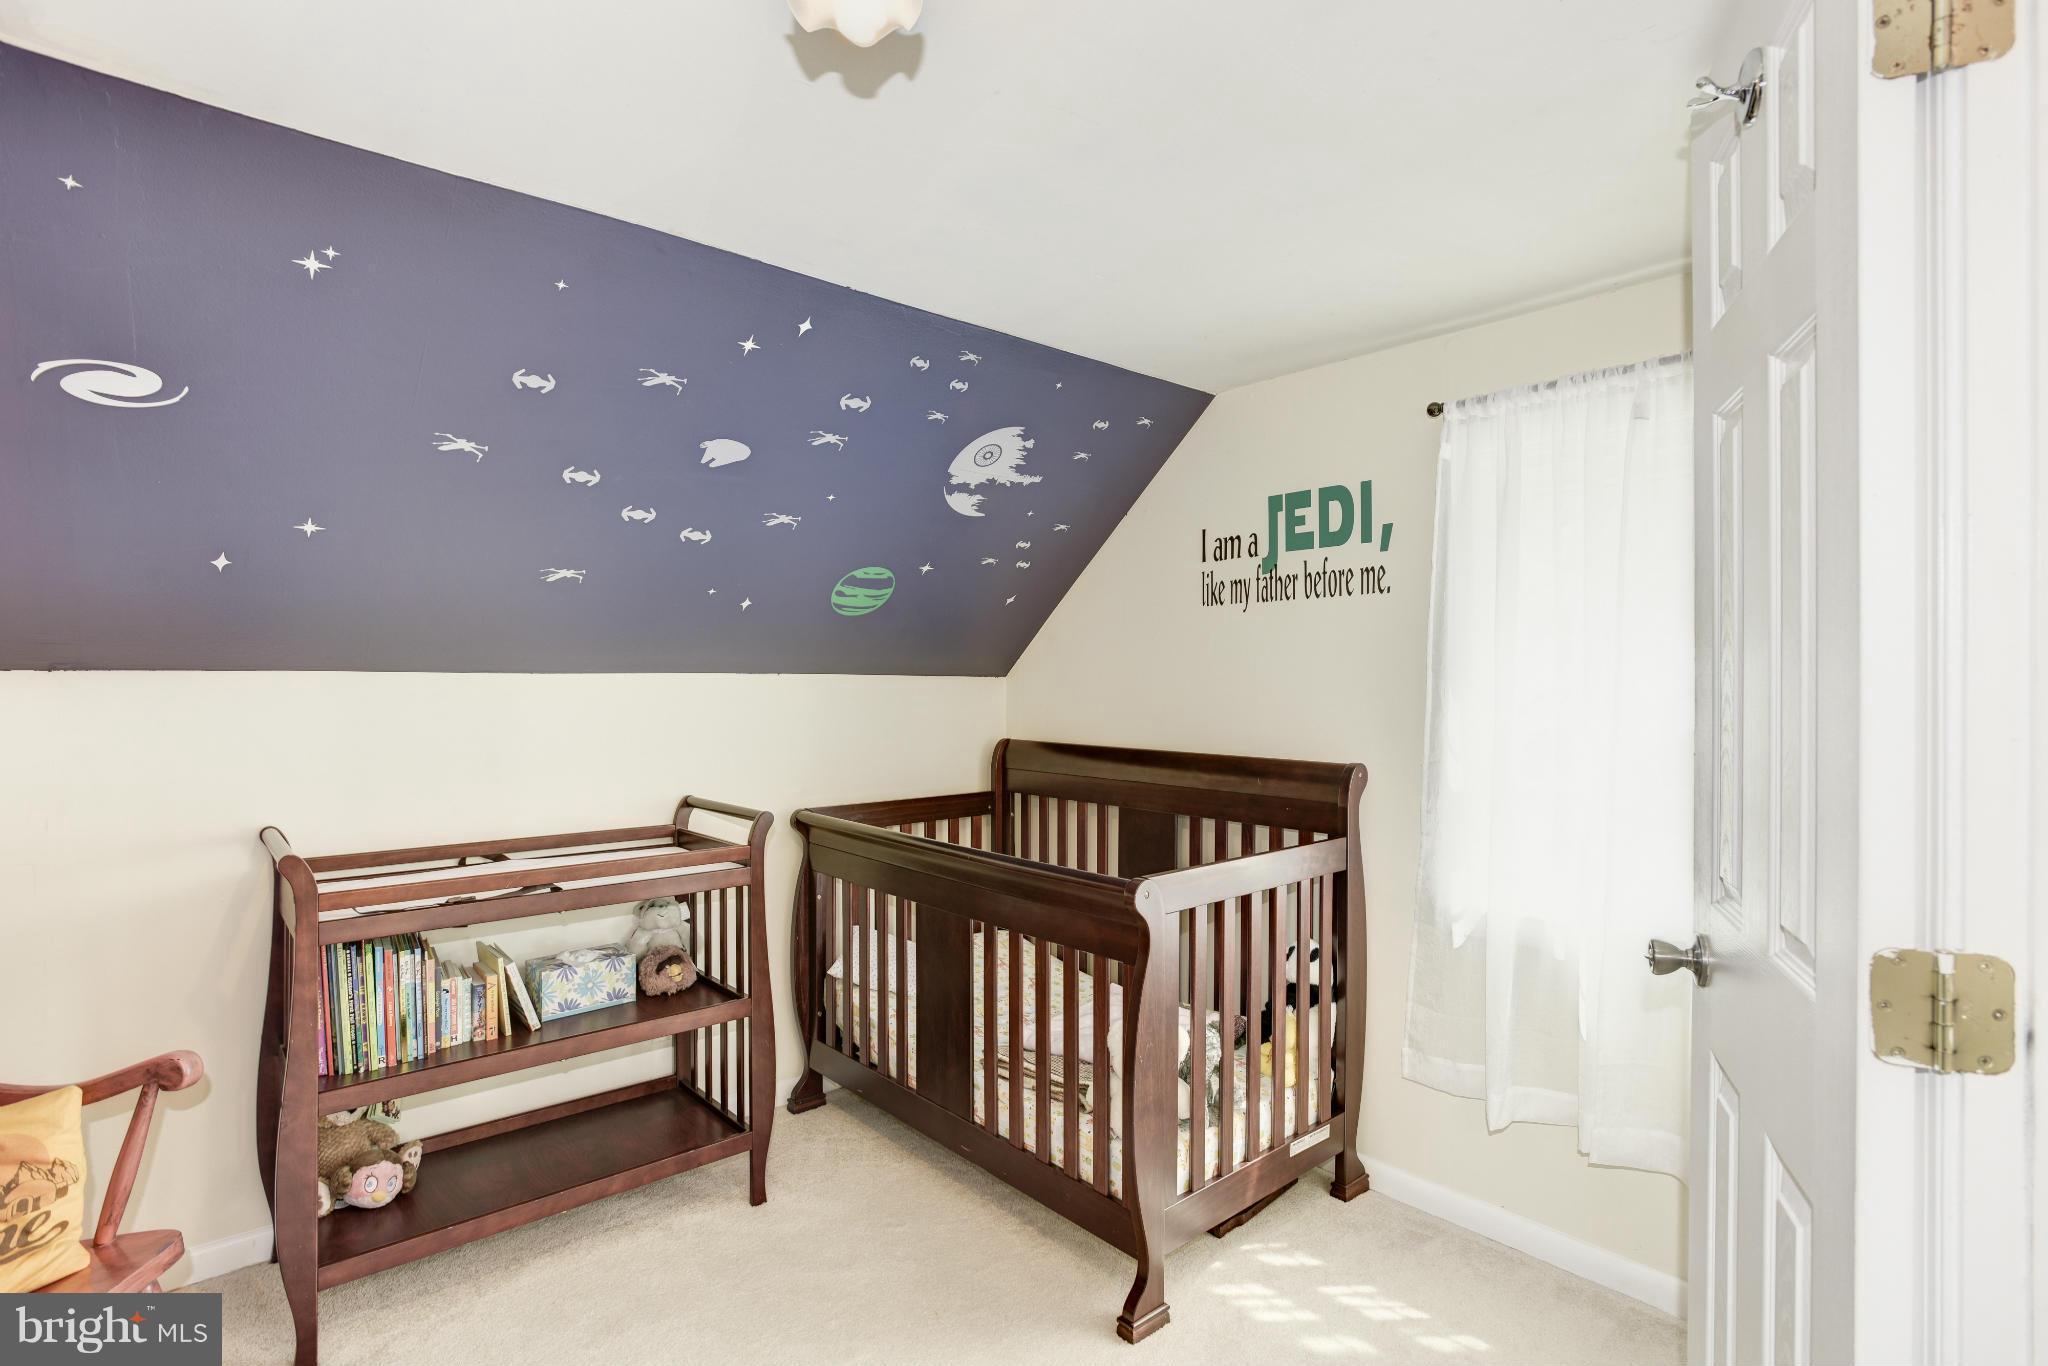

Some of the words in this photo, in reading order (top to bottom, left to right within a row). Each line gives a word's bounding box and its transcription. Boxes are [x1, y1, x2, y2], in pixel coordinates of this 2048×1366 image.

[1201, 529, 1207, 563] I
[1213, 534, 1242, 562] am
[1248, 532, 1259, 558] a
[1261, 479, 1394, 575] JEDI,
[1201, 570, 1226, 607] like
[1230, 577, 1251, 613] my
[1255, 563, 1299, 603] father
[1303, 556, 1355, 600] before
[1359, 563, 1392, 596] me.
[378, 1056, 386, 1065] R
